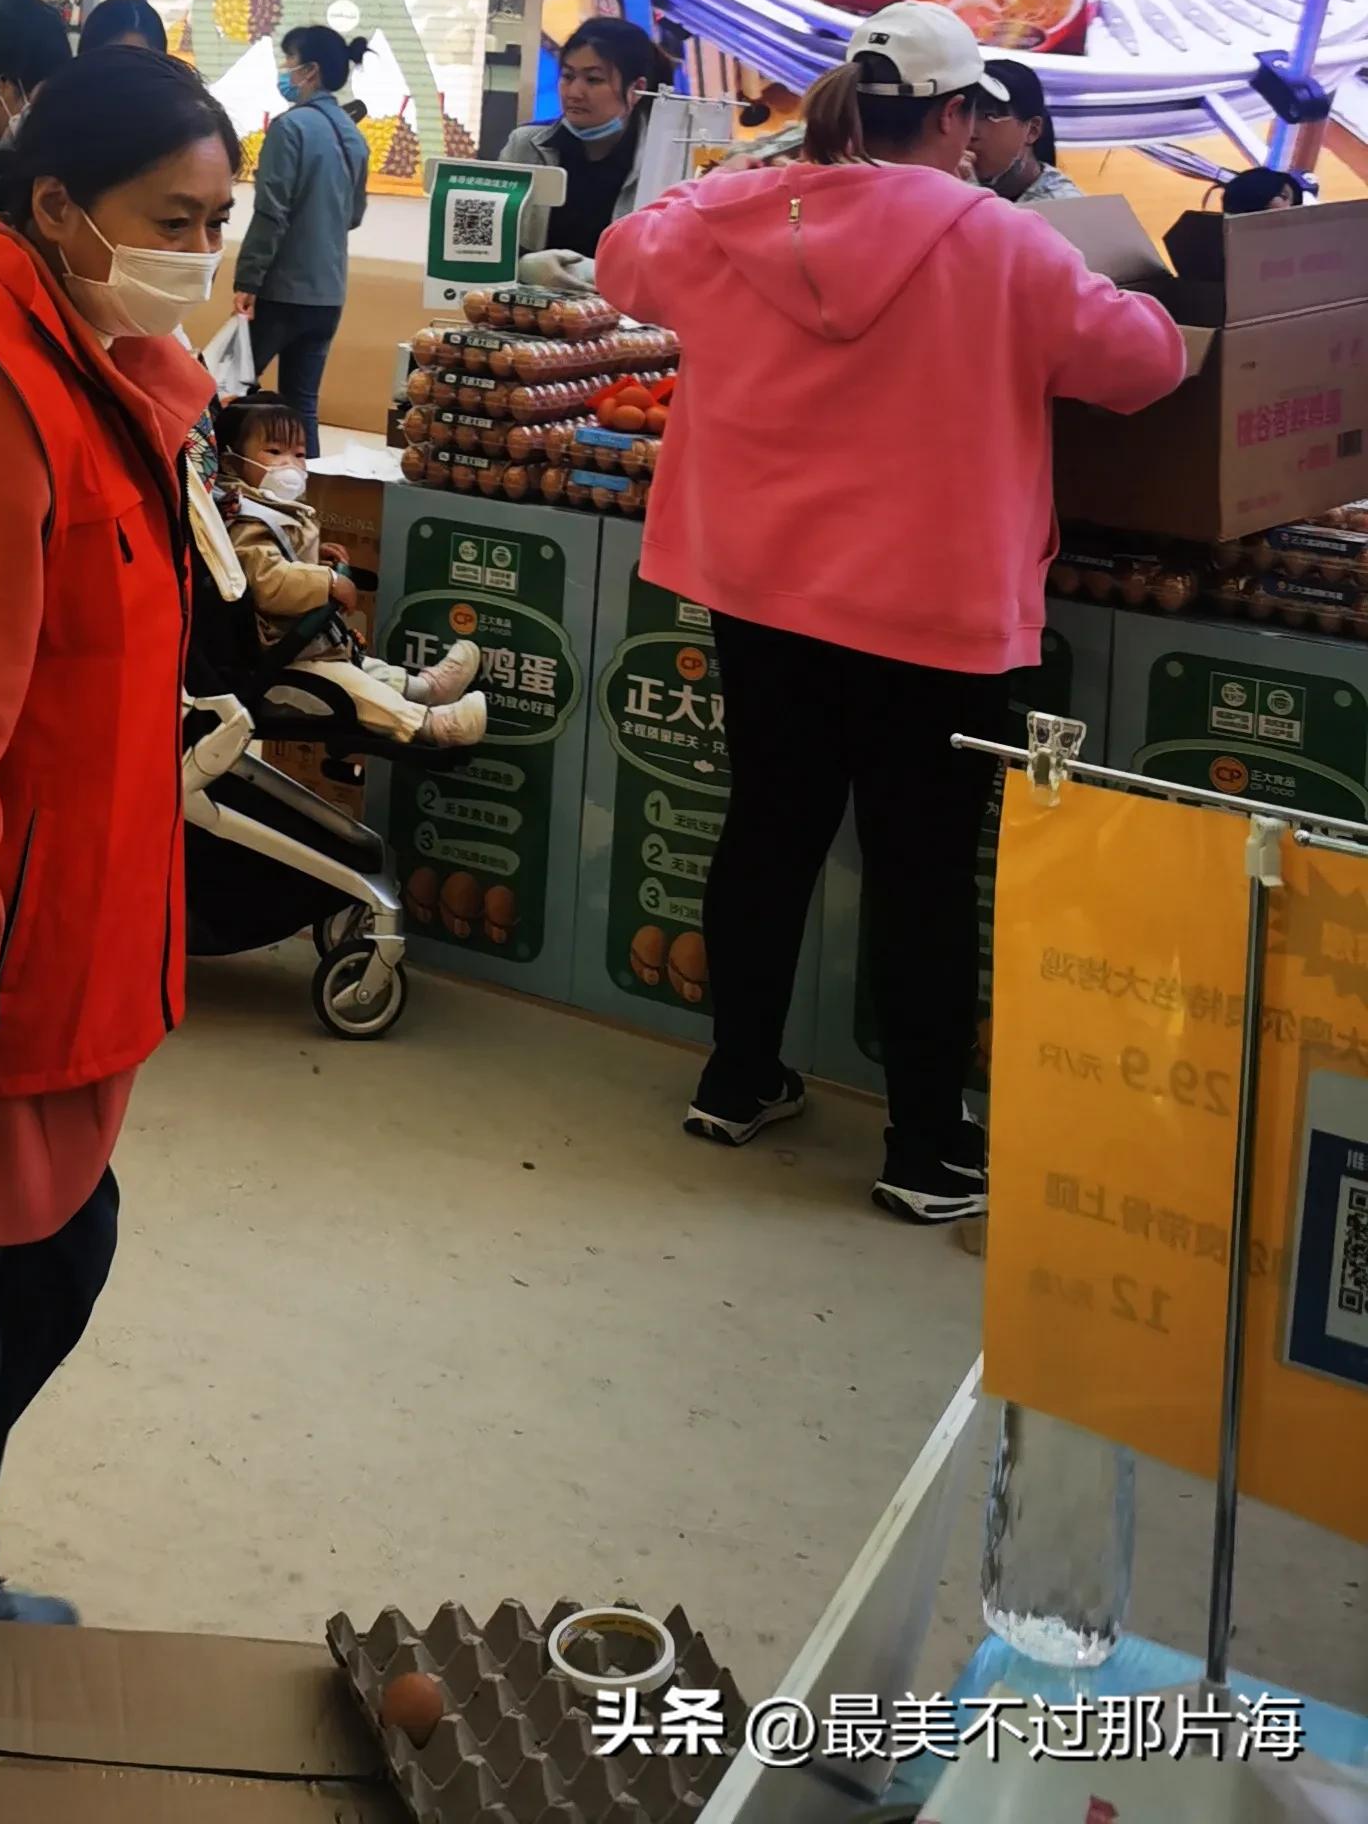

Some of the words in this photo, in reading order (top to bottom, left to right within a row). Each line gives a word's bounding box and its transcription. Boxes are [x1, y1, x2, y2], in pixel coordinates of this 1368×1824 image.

[402, 629, 558, 698] 正鸡蛋
[421, 789, 436, 810] 2
[650, 800, 661, 822] 1
[419, 830, 434, 850] 3
[647, 843, 663, 866] 2
[645, 886, 660, 909] 3
